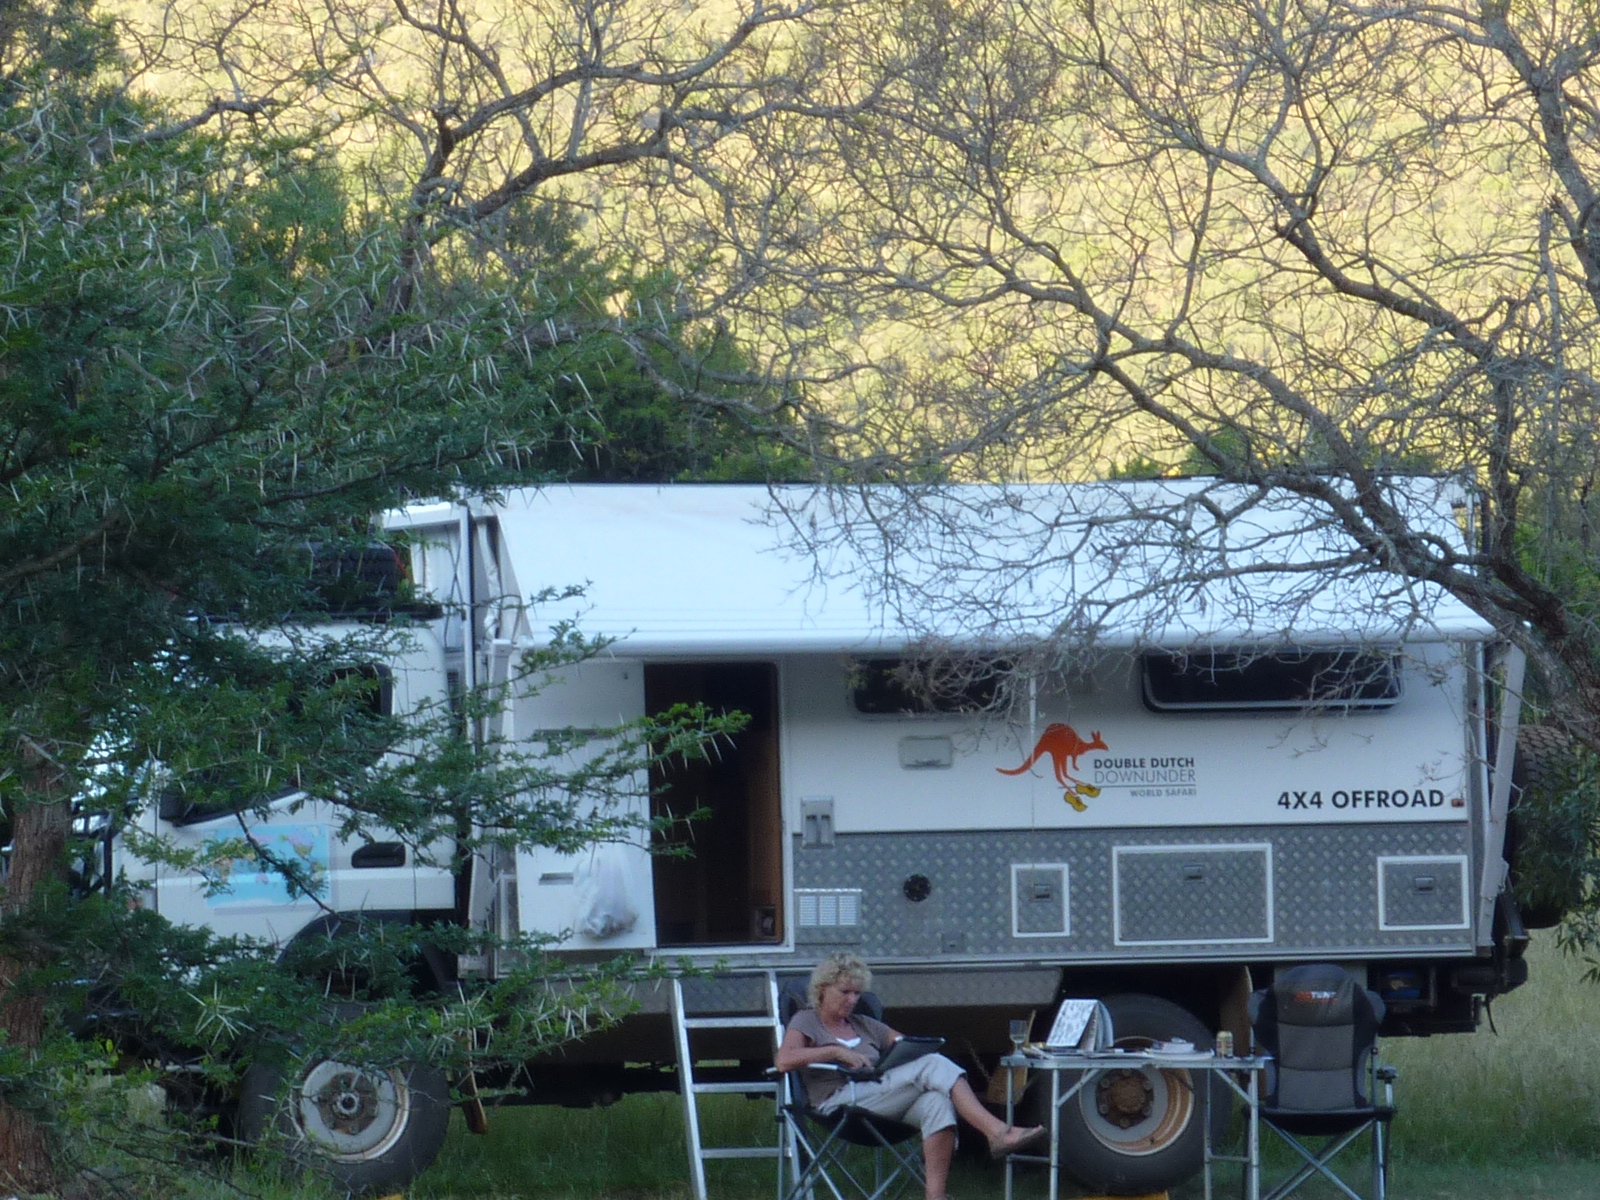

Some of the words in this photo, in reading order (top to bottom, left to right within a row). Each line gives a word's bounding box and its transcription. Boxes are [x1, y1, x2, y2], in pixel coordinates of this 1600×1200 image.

[1094, 758, 1146, 769] DOUBLE
[1151, 757, 1195, 768] DUTCH
[1094, 769, 1196, 784] DOWNUNDER
[1130, 789, 1162, 797] WORLD
[1165, 788, 1197, 796] SAFARI
[1277, 791, 1323, 809] 4X4
[1331, 789, 1444, 809] OFFROAD
